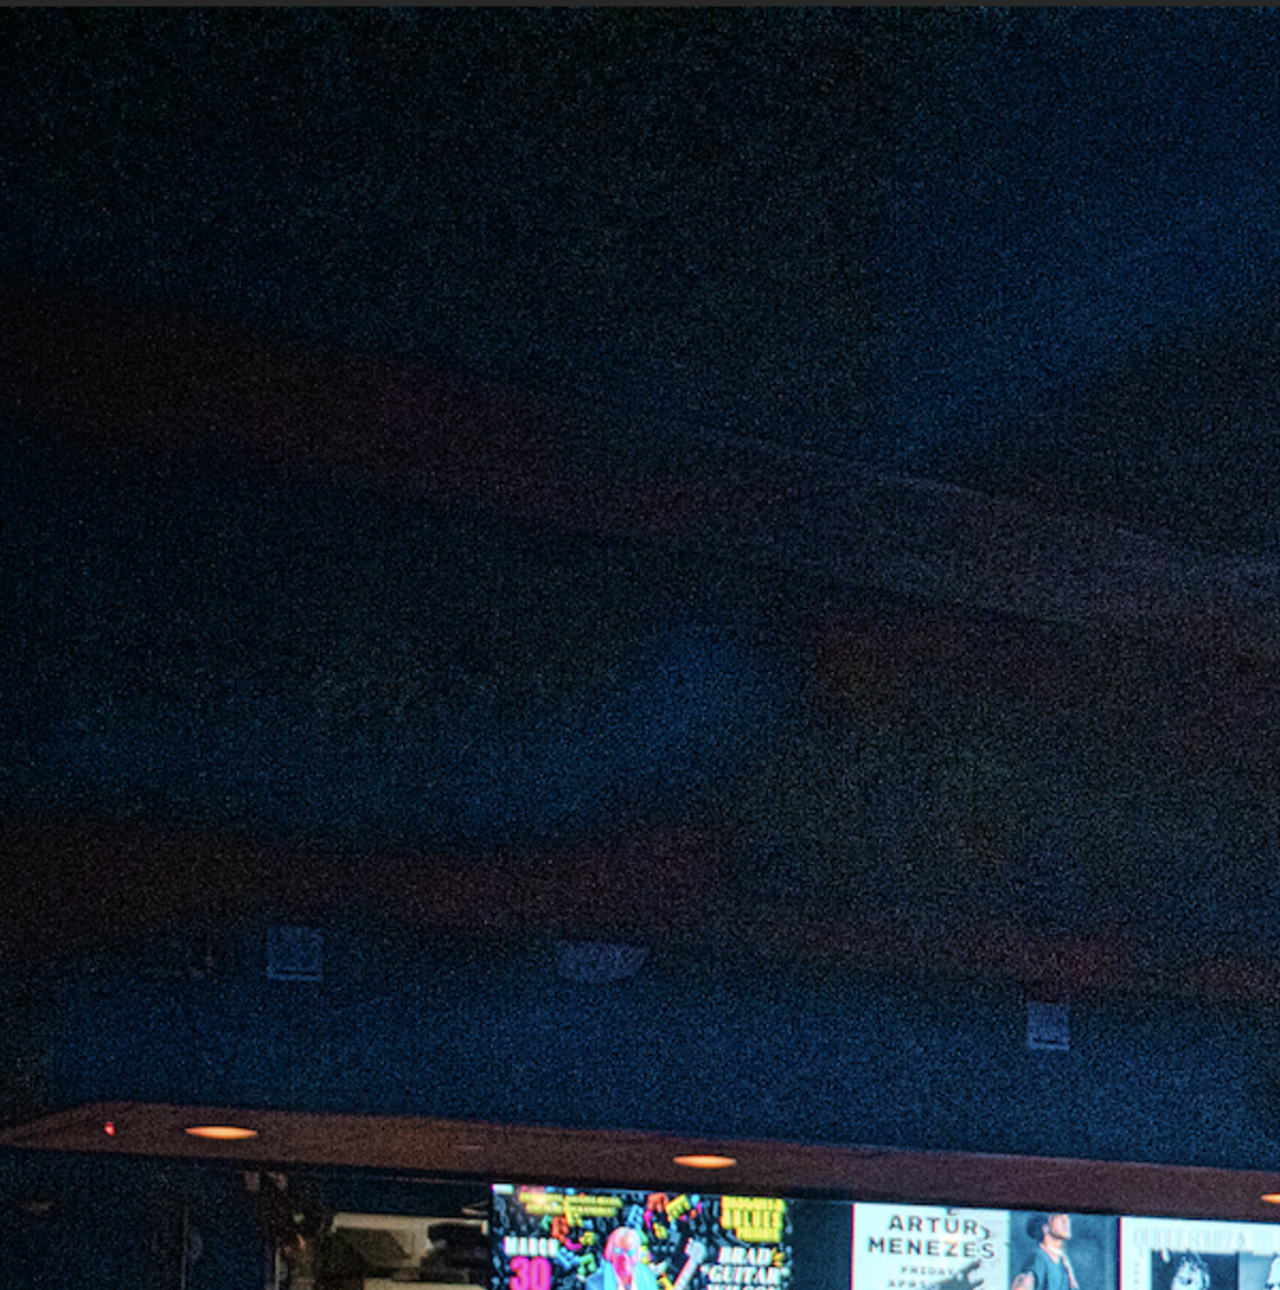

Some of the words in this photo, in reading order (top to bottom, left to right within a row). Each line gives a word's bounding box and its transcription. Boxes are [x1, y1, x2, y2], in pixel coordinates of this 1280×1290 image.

[888, 1215, 978, 1234] ARTUR
[504, 1236, 559, 1257] MARCH
[718, 1247, 772, 1264] BRAD
[869, 1236, 995, 1259] MENEZES
